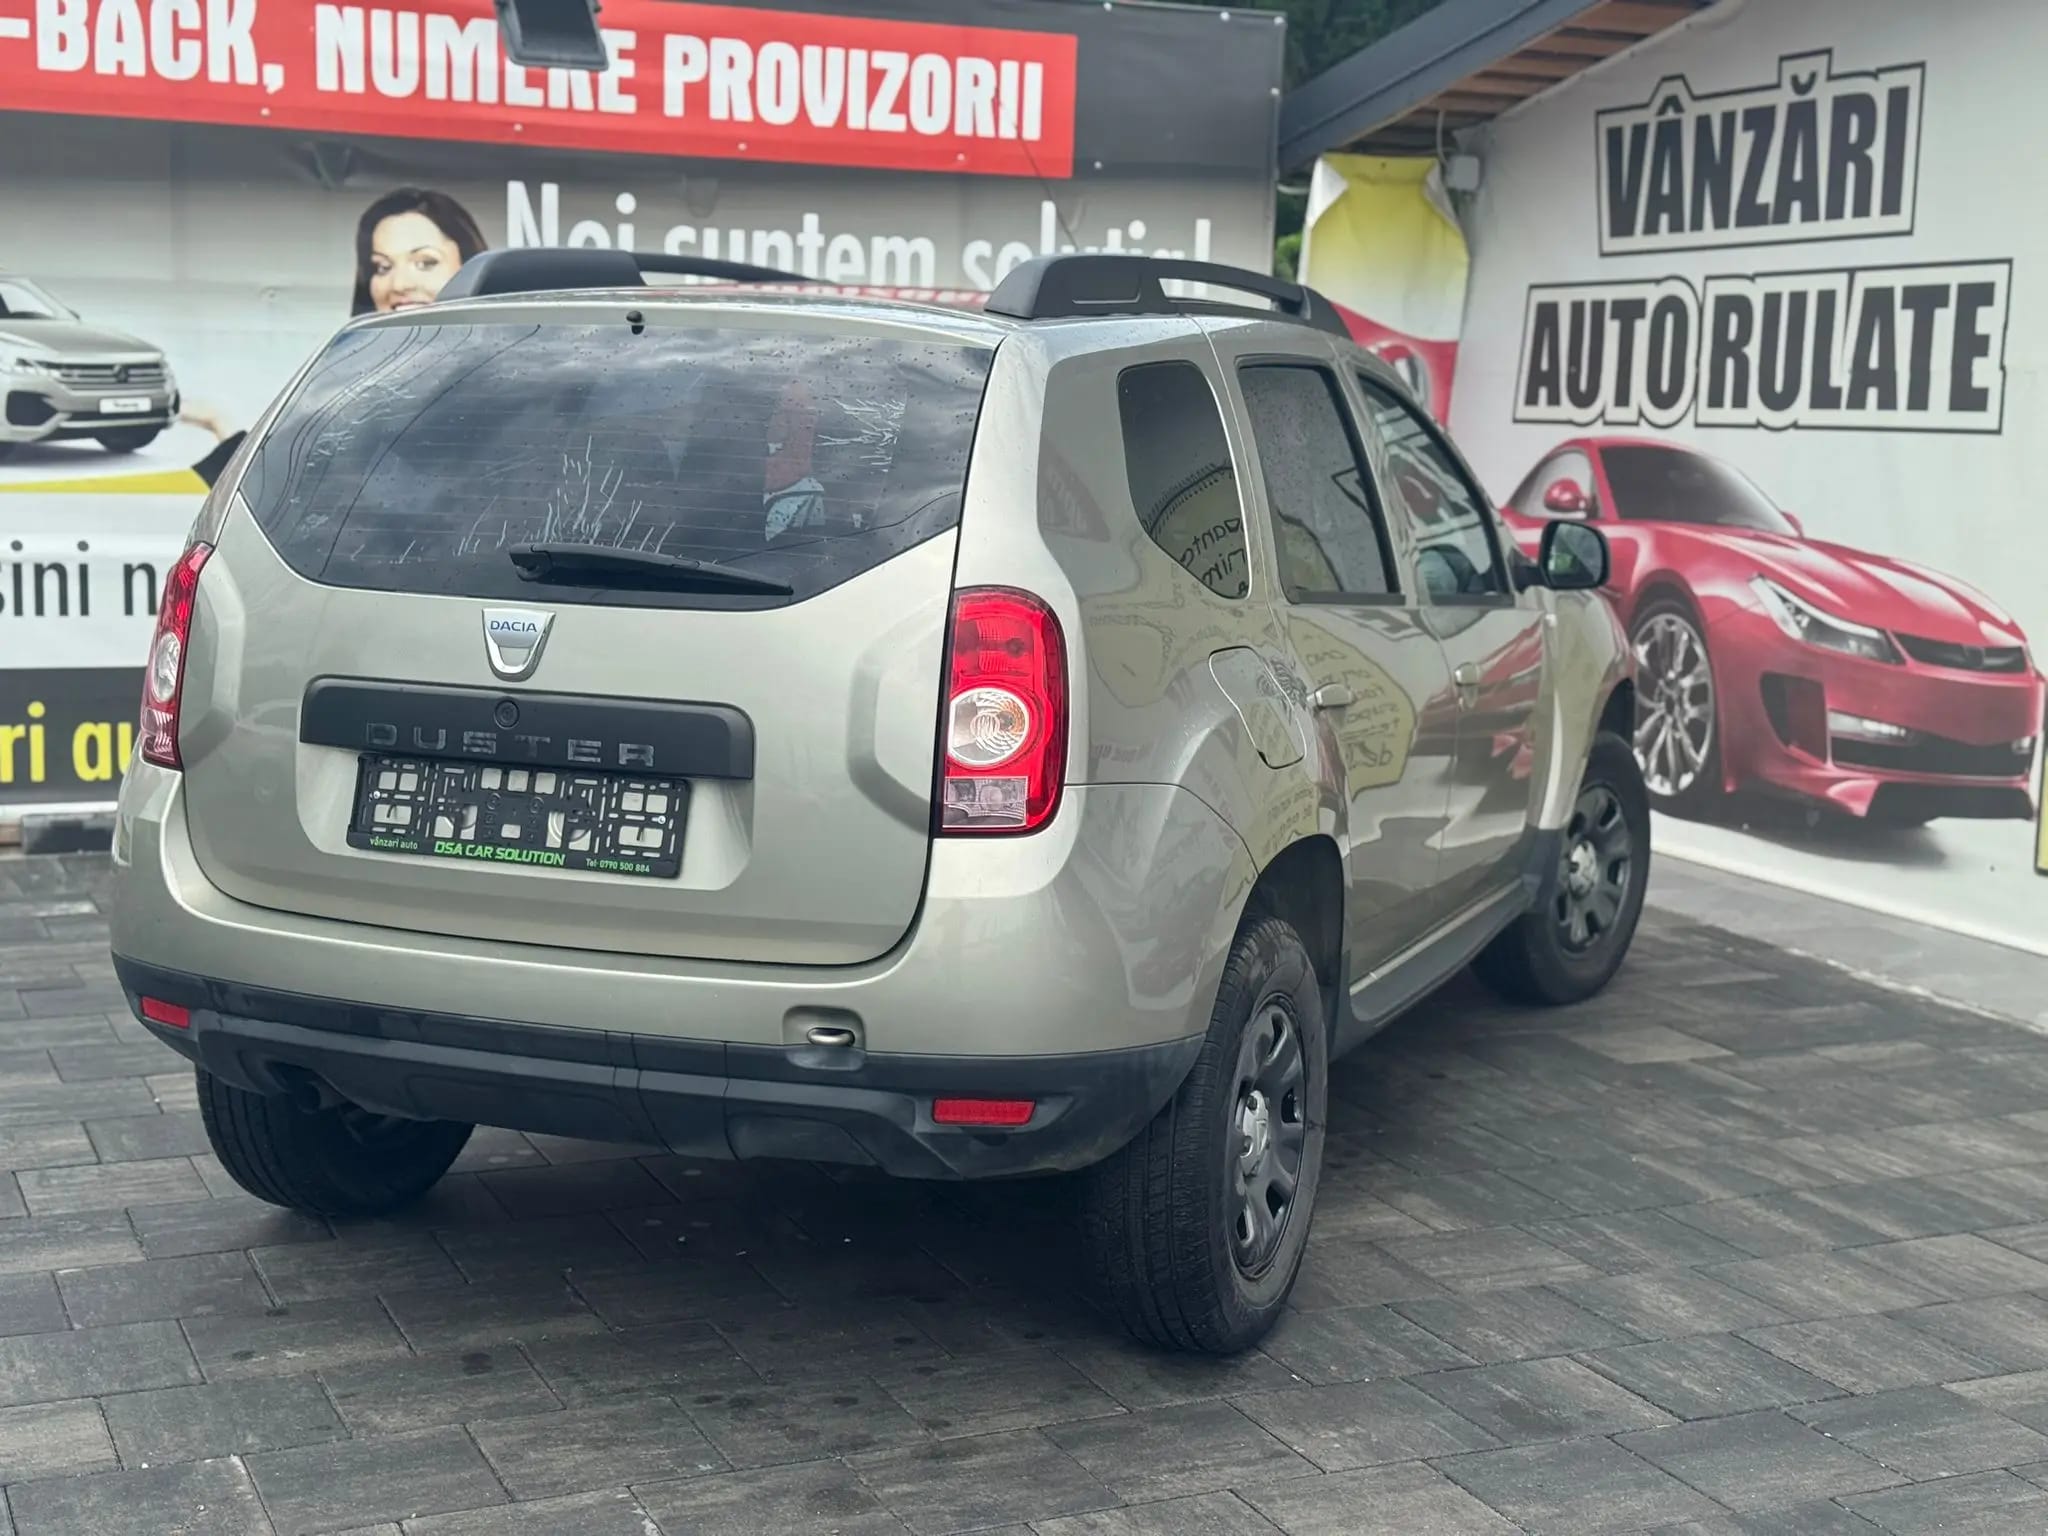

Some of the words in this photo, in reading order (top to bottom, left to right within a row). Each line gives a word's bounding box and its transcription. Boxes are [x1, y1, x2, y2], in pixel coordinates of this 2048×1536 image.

[663, 34, 1043, 141] PROVIZORII
[1605, 70, 1911, 239] VÂNZĂRI
[1524, 294, 1689, 412] AUTO
[1707, 281, 1997, 413] RULATE
[0, 540, 90, 616] ini
[490, 620, 537, 632] DACIA
[366, 722, 654, 767] DUSTER
[400, 840, 418, 850] auto
[465, 844, 494, 859] CAR
[495, 847, 566, 866] SOLUTION
[619, 862, 634, 871] 500
